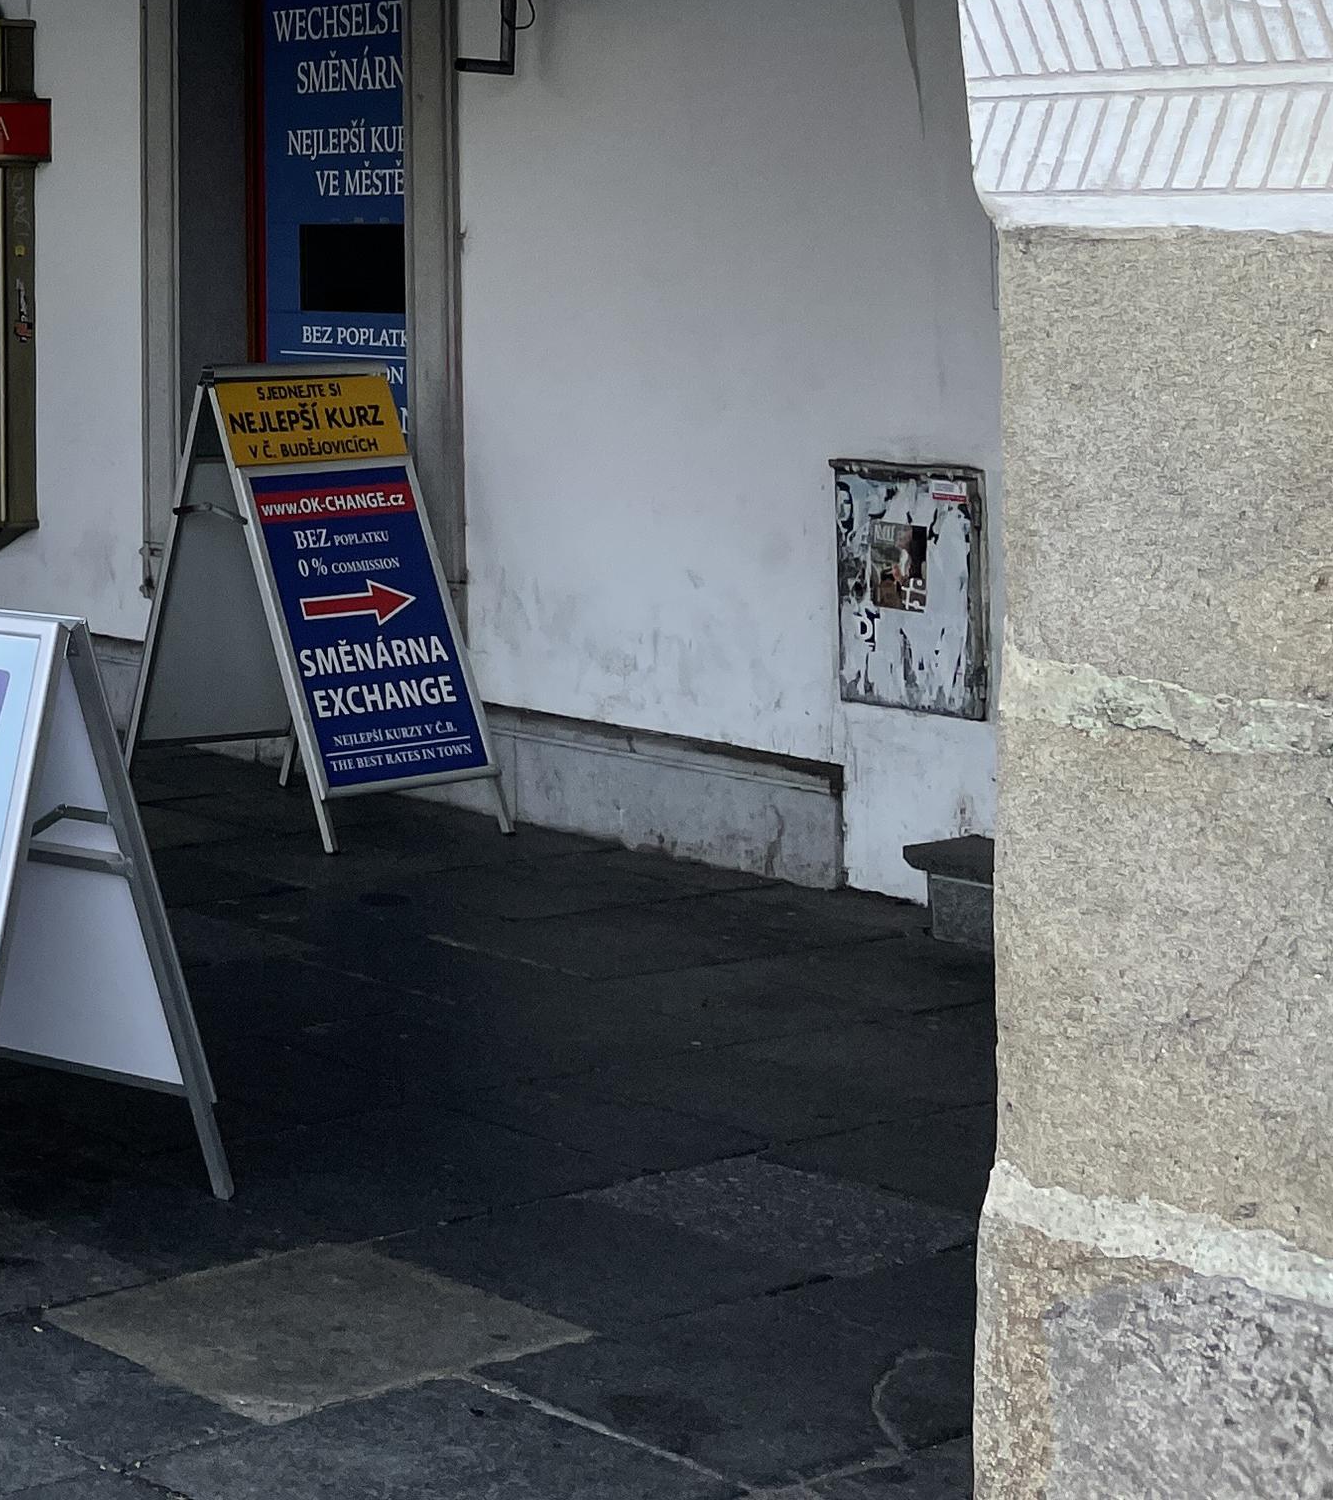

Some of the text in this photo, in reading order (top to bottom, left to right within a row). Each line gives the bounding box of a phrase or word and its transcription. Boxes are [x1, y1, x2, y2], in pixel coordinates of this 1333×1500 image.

[287, 118, 366, 161] NEJLEPŠÍ
[315, 159, 405, 197] VE MĚSTĚ
[301, 325, 333, 344] BEZ
[257, 383, 342, 401] SJEDNEJTE SI
[229, 402, 321, 434] NEJLEPŠÍ
[325, 404, 384, 430] KURZ
[248, 435, 379, 459] V Č. BUDĚJOVICÍCH
[261, 492, 406, 517] www.OK-CHANGE.cz
[293, 528, 390, 550] BEZ POPLATKU
[298, 556, 400, 577] 0 % COMMISSION
[299, 634, 449, 678] SMĚNÁRNA
[313, 675, 457, 719] EXCHANGE
[333, 727, 384, 748] NEJLEPŠÍ
[386, 724, 424, 741] KURZY
[330, 743, 472, 772] THE BEST RATES IN TOWN
